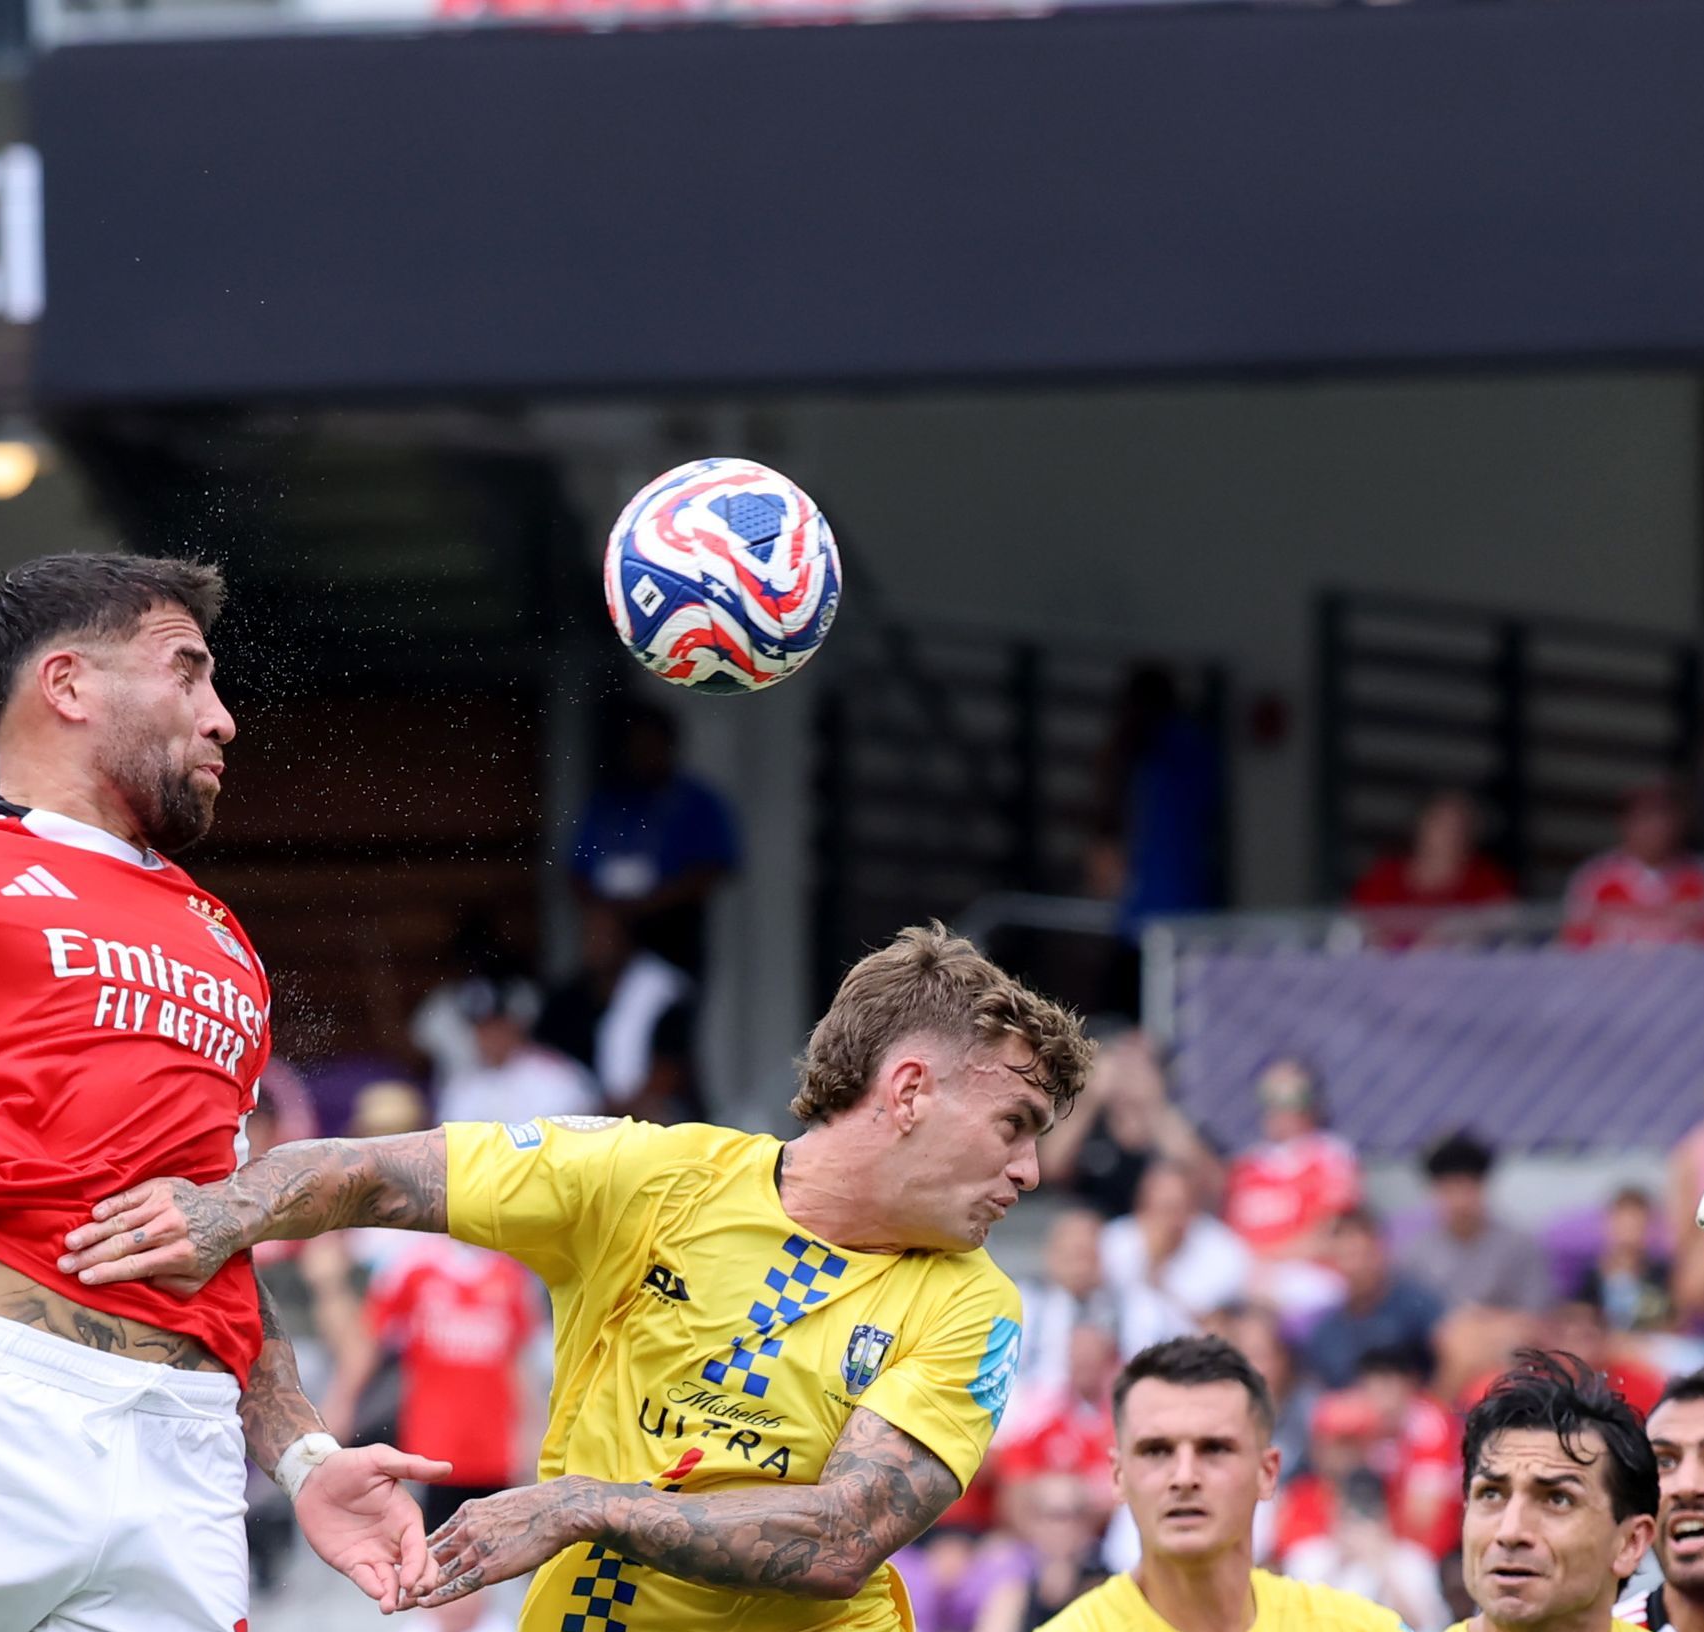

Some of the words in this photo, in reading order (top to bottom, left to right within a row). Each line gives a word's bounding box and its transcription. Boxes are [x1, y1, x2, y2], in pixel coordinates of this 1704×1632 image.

[42, 928, 263, 1049] Emirates
[93, 985, 151, 1032] FLY
[158, 999, 245, 1076] BETTER
[667, 1381, 788, 1428] Michelob
